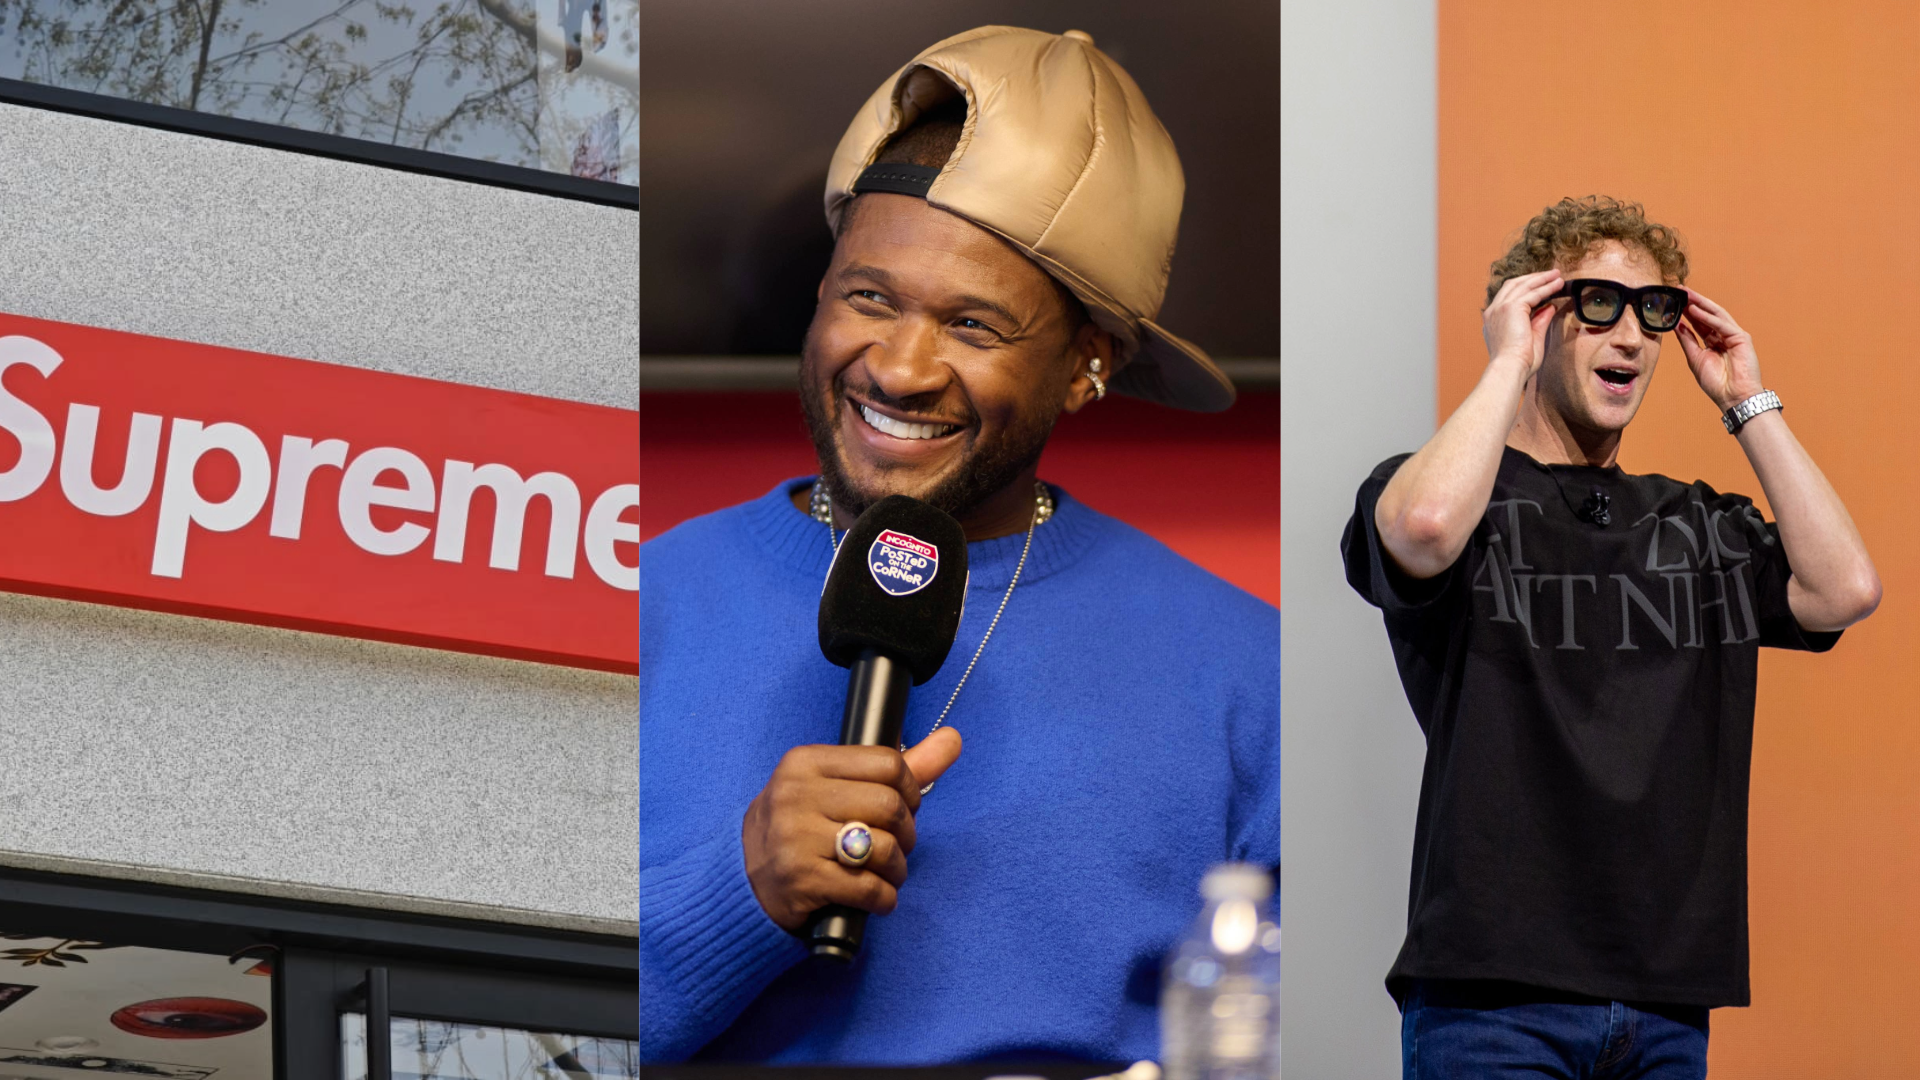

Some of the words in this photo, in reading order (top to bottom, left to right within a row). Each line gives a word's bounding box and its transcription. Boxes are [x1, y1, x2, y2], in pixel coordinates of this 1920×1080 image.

[0, 335, 639, 591] Supreme
[886, 535, 931, 555] INCOGNITO
[888, 558, 900, 567] ON
[900, 561, 913, 572] THE
